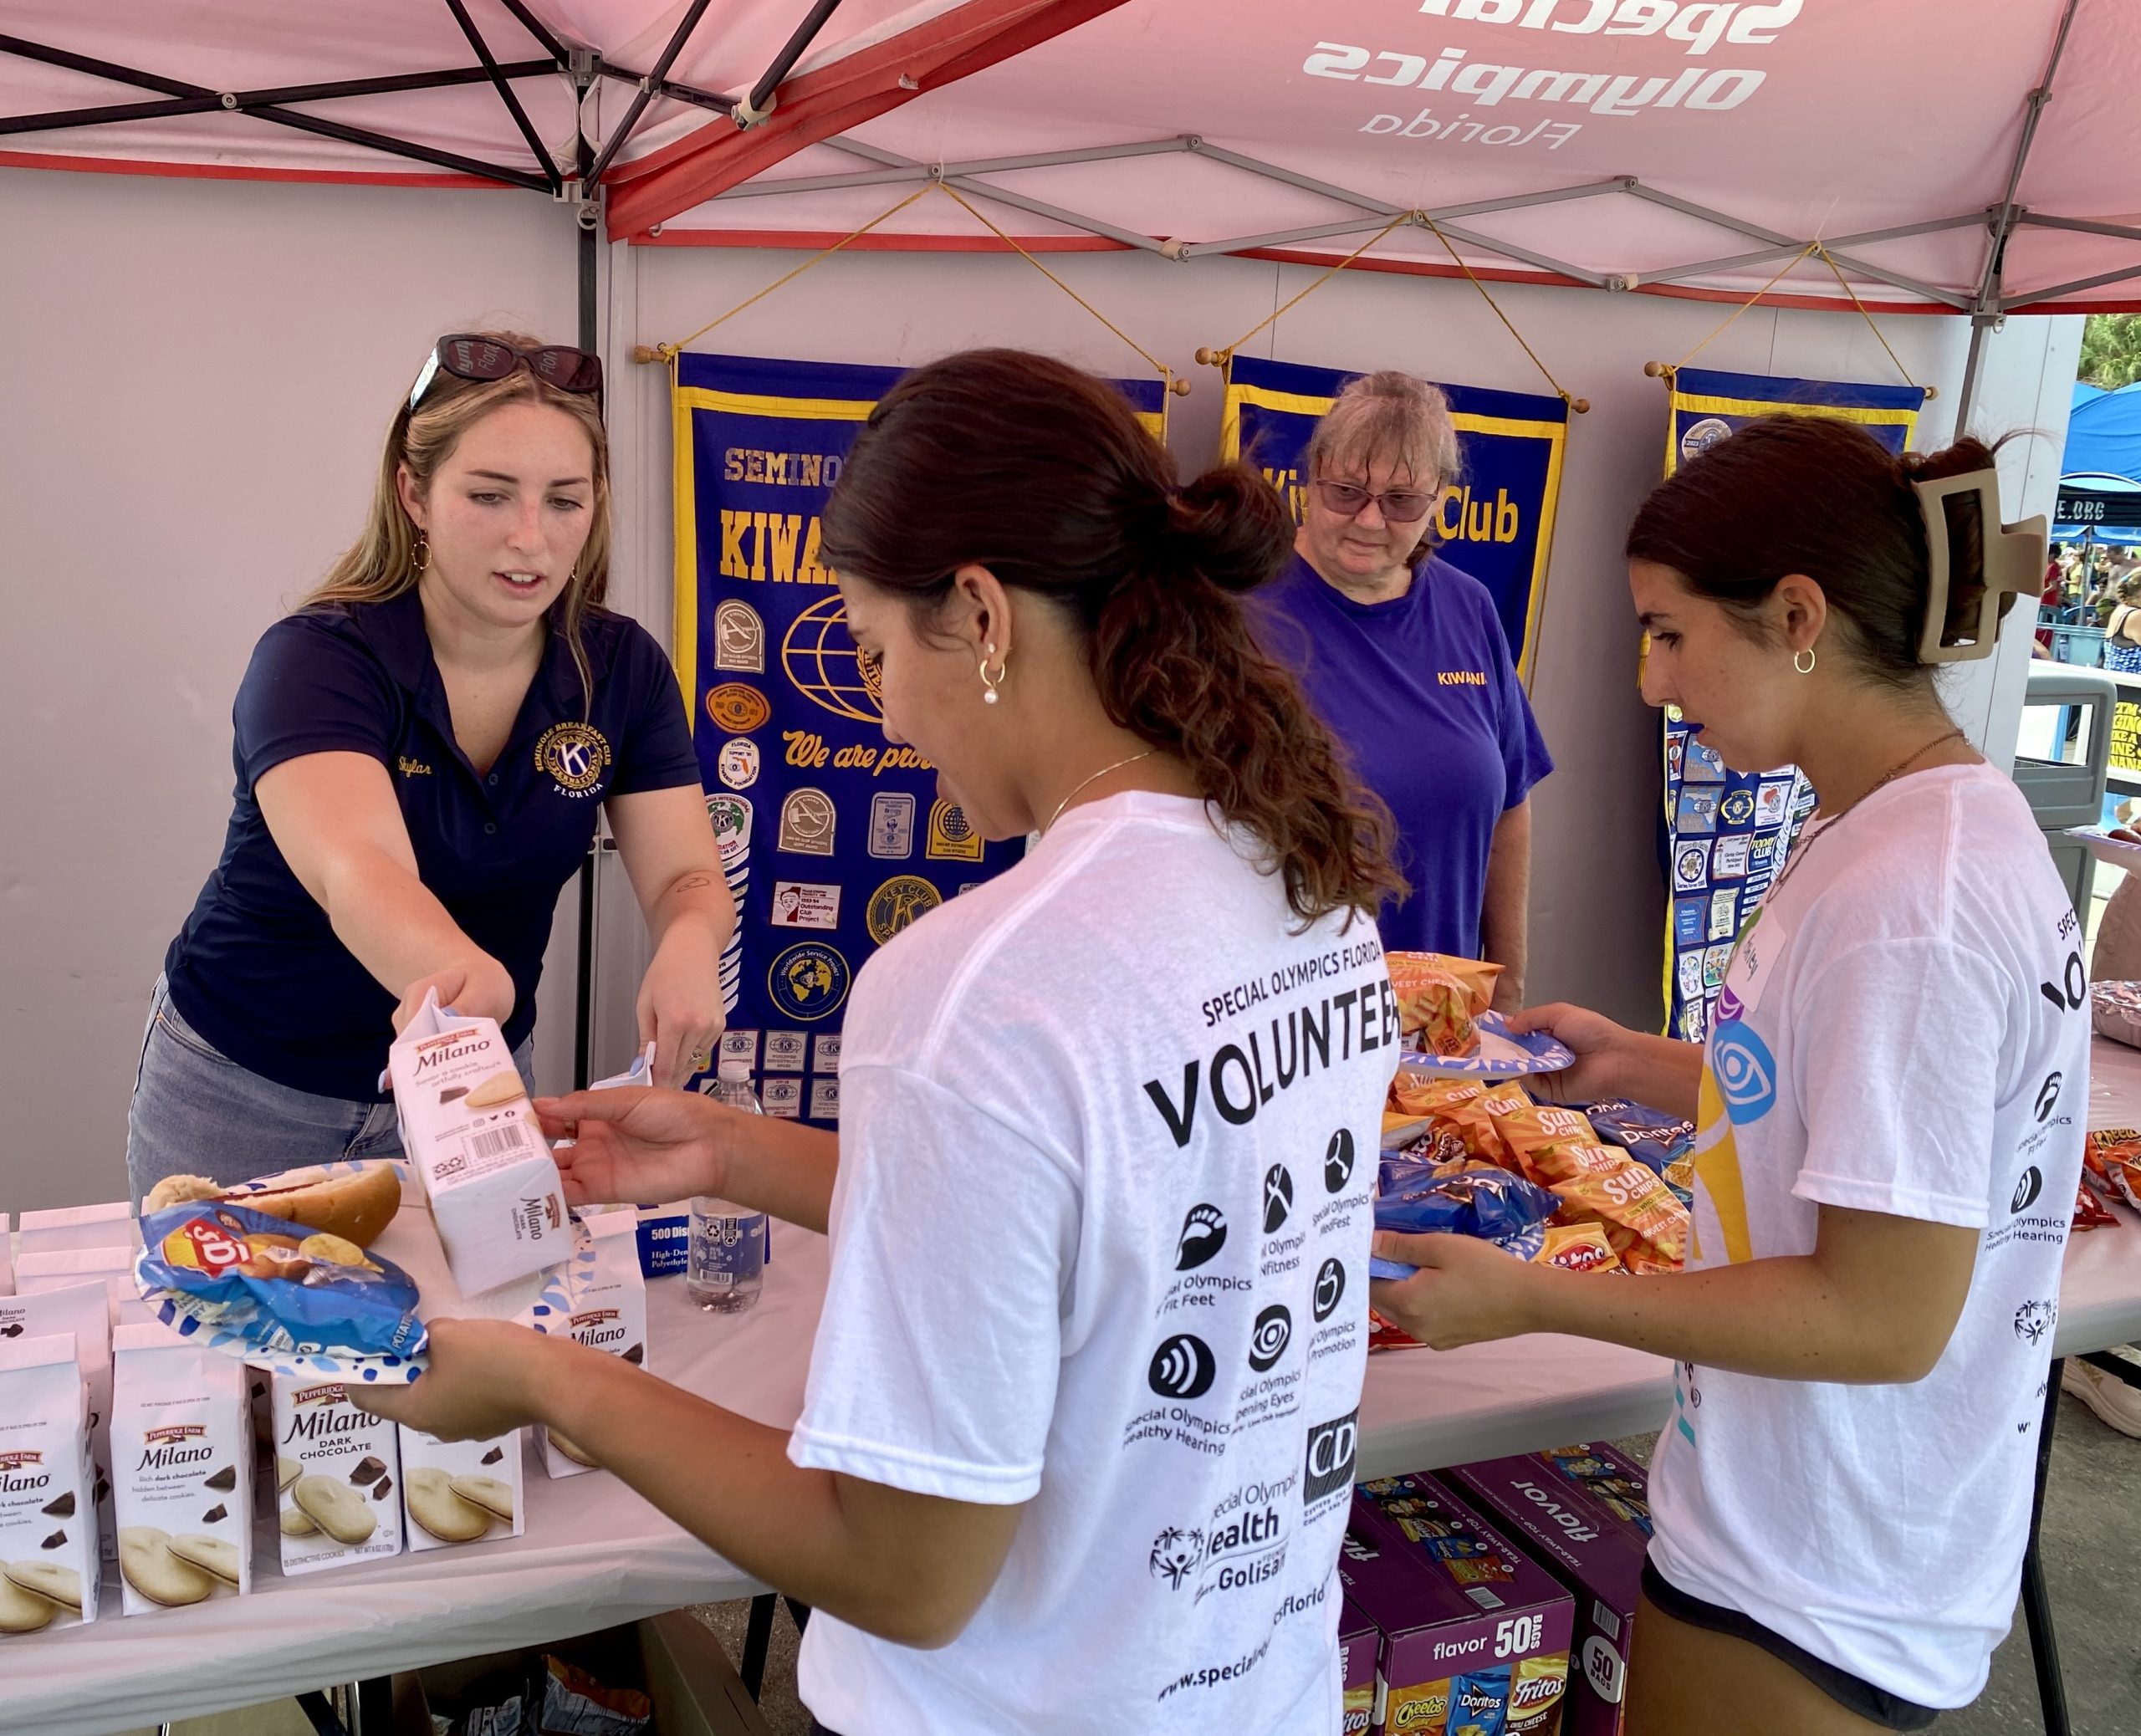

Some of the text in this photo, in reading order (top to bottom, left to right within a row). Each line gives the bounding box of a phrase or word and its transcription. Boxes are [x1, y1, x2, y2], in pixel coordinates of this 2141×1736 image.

[724, 447, 846, 488] SEMINO
[1438, 485, 1519, 544] Club
[720, 509, 839, 585] KIWA
[1438, 671, 1487, 686] KIWANI
[783, 730, 830, 768] We
[834, 744, 877, 768] are
[554, 783, 603, 798] FLORIDA
[717, 840, 737, 850] DATION
[1750, 836, 1775, 850] TODAY
[1753, 846, 1772, 860] CLUB
[800, 903, 834, 911] Outstanding
[883, 886, 933, 907] KEY CLUB
[2057, 906, 2078, 942] SPEC
[780, 950, 840, 977] Worldwide Service Project
[1203, 978, 1269, 1028] SPECIAL
[1271, 952, 1340, 996] OLYMPICS
[1392, 979, 1418, 988] VEST
[412, 1039, 491, 1077] Milano
[1484, 1096, 1524, 1117] Sun
[1537, 1109, 1579, 1136] Sun
[1619, 1120, 1695, 1145] Doritos
[1571, 1144, 1612, 1167] Sun
[1602, 1167, 1650, 1205] Sun
[1630, 1177, 1660, 1200] CHIPS
[520, 1197, 544, 1241] Milano
[651, 1225, 690, 1240] 500 Dis
[2012, 1230, 2063, 1245] Hearing
[651, 1259, 687, 1269] Polyethyle
[1183, 1273, 1253, 1290] Olympics
[1182, 1293, 1216, 1307] Feet
[570, 1327, 626, 1346] Milano
[299, 1384, 345, 1402] PEPPERIDGE
[1239, 1383, 1258, 1402] cial
[1235, 1391, 1295, 1423] pening Eyes
[281, 1408, 382, 1446] Milano
[1124, 1407, 1231, 1436] pecial Olympics
[149, 1427, 202, 1441] PEPPERIDGE FARM
[319, 1435, 352, 1448] DARK
[1122, 1424, 1226, 1457] ealthy Hearing
[135, 1446, 212, 1472] Milano
[299, 1442, 372, 1460] CHOCOLATE
[0, 1473, 50, 1493] ilano
[172, 1470, 207, 1480] chocolate
[8, 1498, 44, 1508] chocolate
[141, 1494, 168, 1503] delicate
[1214, 1487, 1243, 1519] ecial
[1510, 1480, 1599, 1543] flavor
[1433, 1614, 1544, 1661] flavor 50 BAGS
[1592, 1646, 1614, 1682] 50
[1590, 1667, 1611, 1692] BAGS
[1460, 1694, 1502, 1710] Doritos
[1512, 1677, 1565, 1708] Fritos
[1343, 1711, 1372, 1733] itos
[1395, 1695, 1449, 1728] Cheetos
[1524, 1712, 1548, 1727] CHEESE
